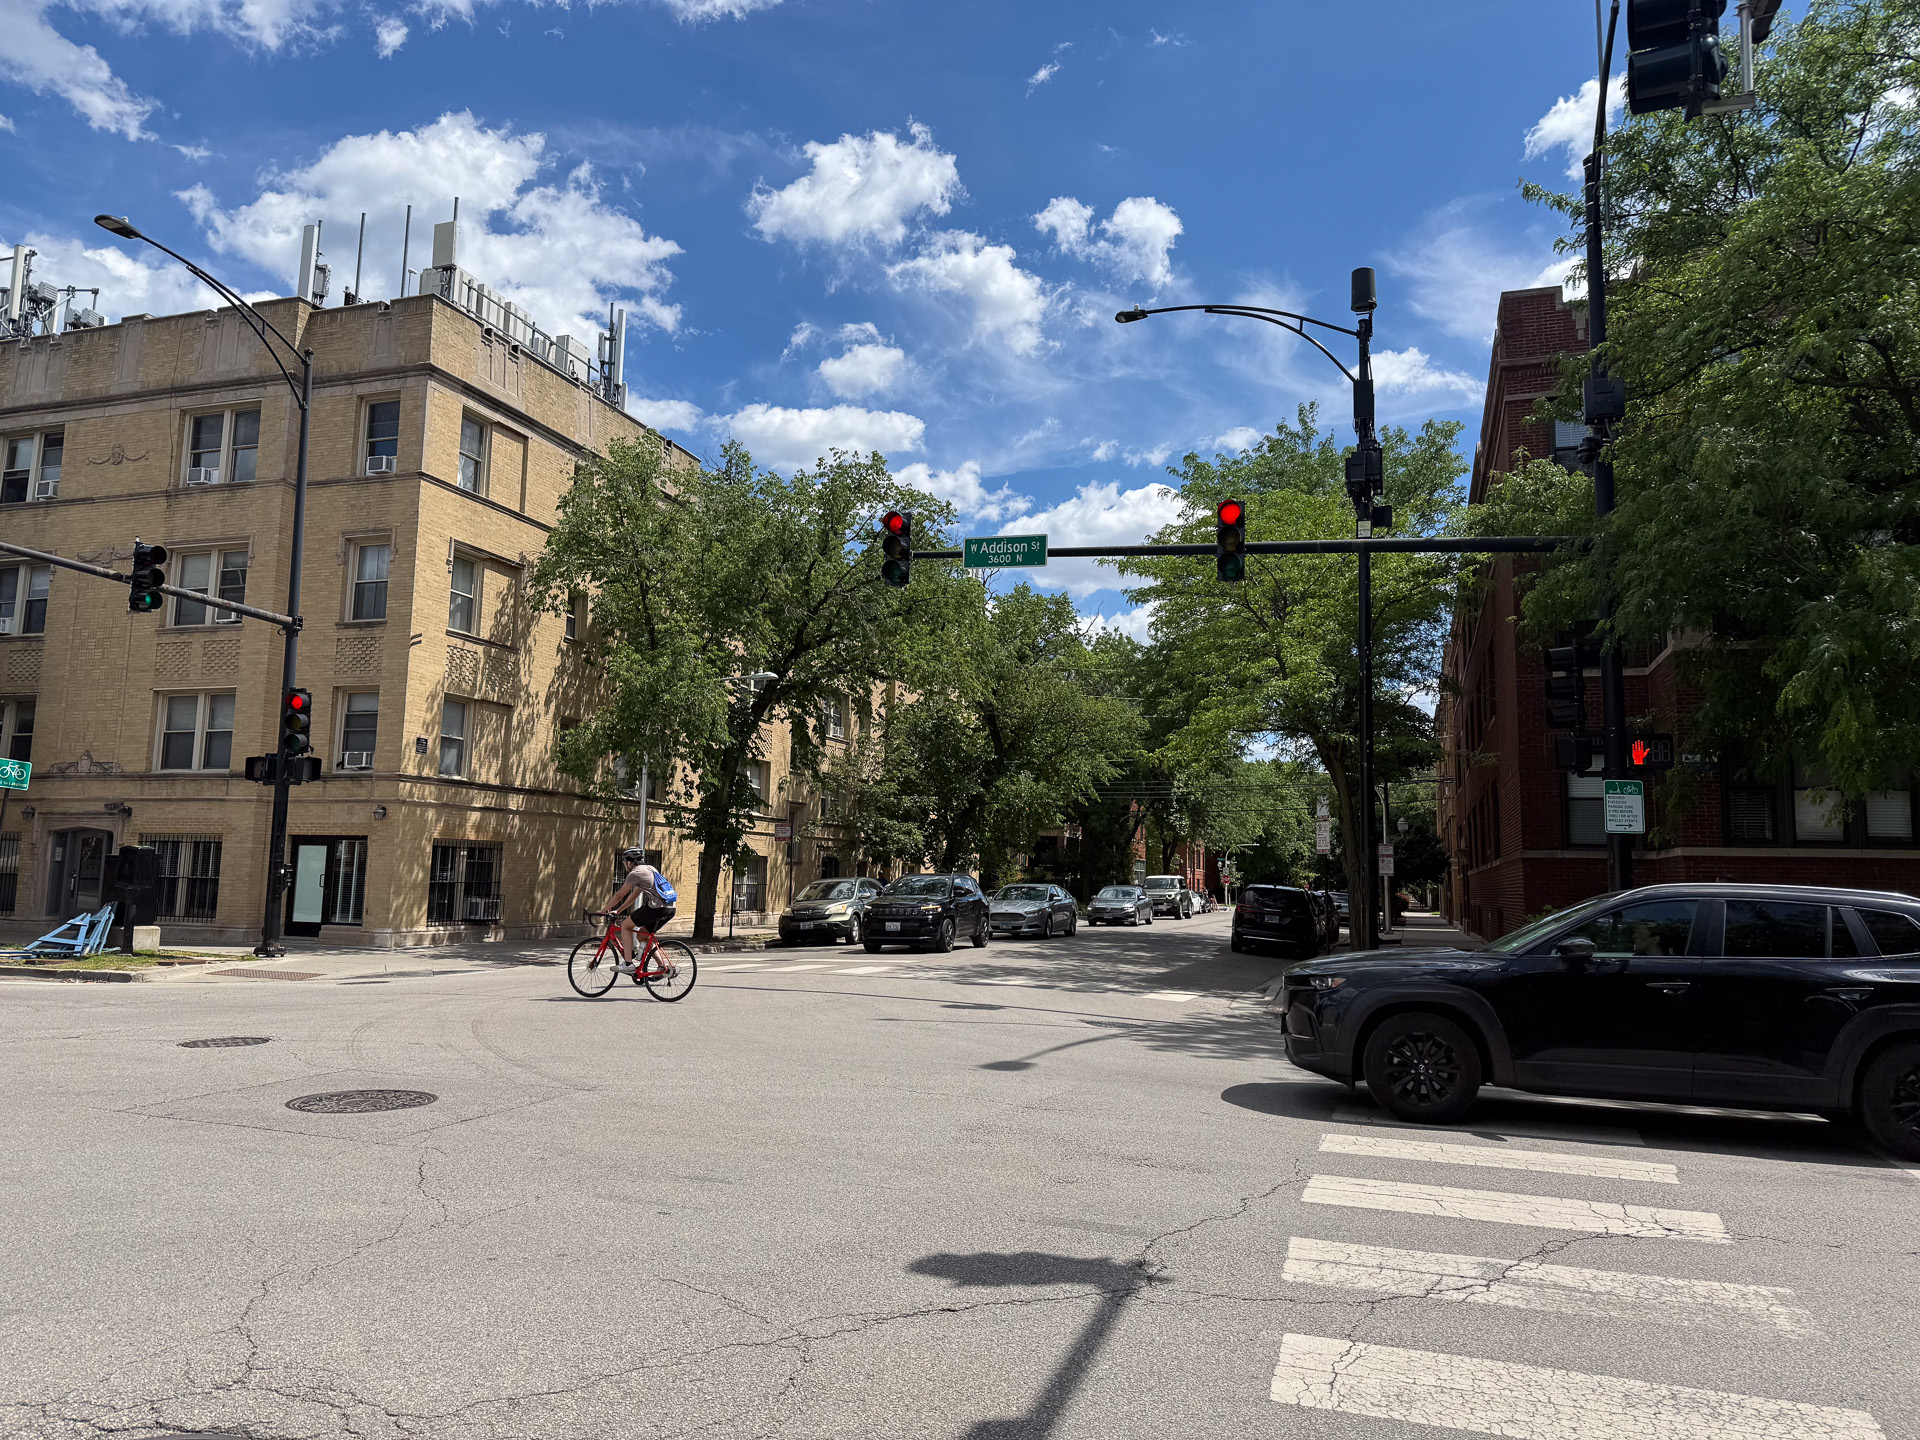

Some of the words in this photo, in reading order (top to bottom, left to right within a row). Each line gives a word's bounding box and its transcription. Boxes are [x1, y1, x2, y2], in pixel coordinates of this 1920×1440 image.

[971, 543, 977, 552] W
[980, 541, 1027, 553] Addison
[1031, 541, 1040, 550] St
[988, 554, 1011, 564] 3600
[1017, 554, 1022, 562] N
